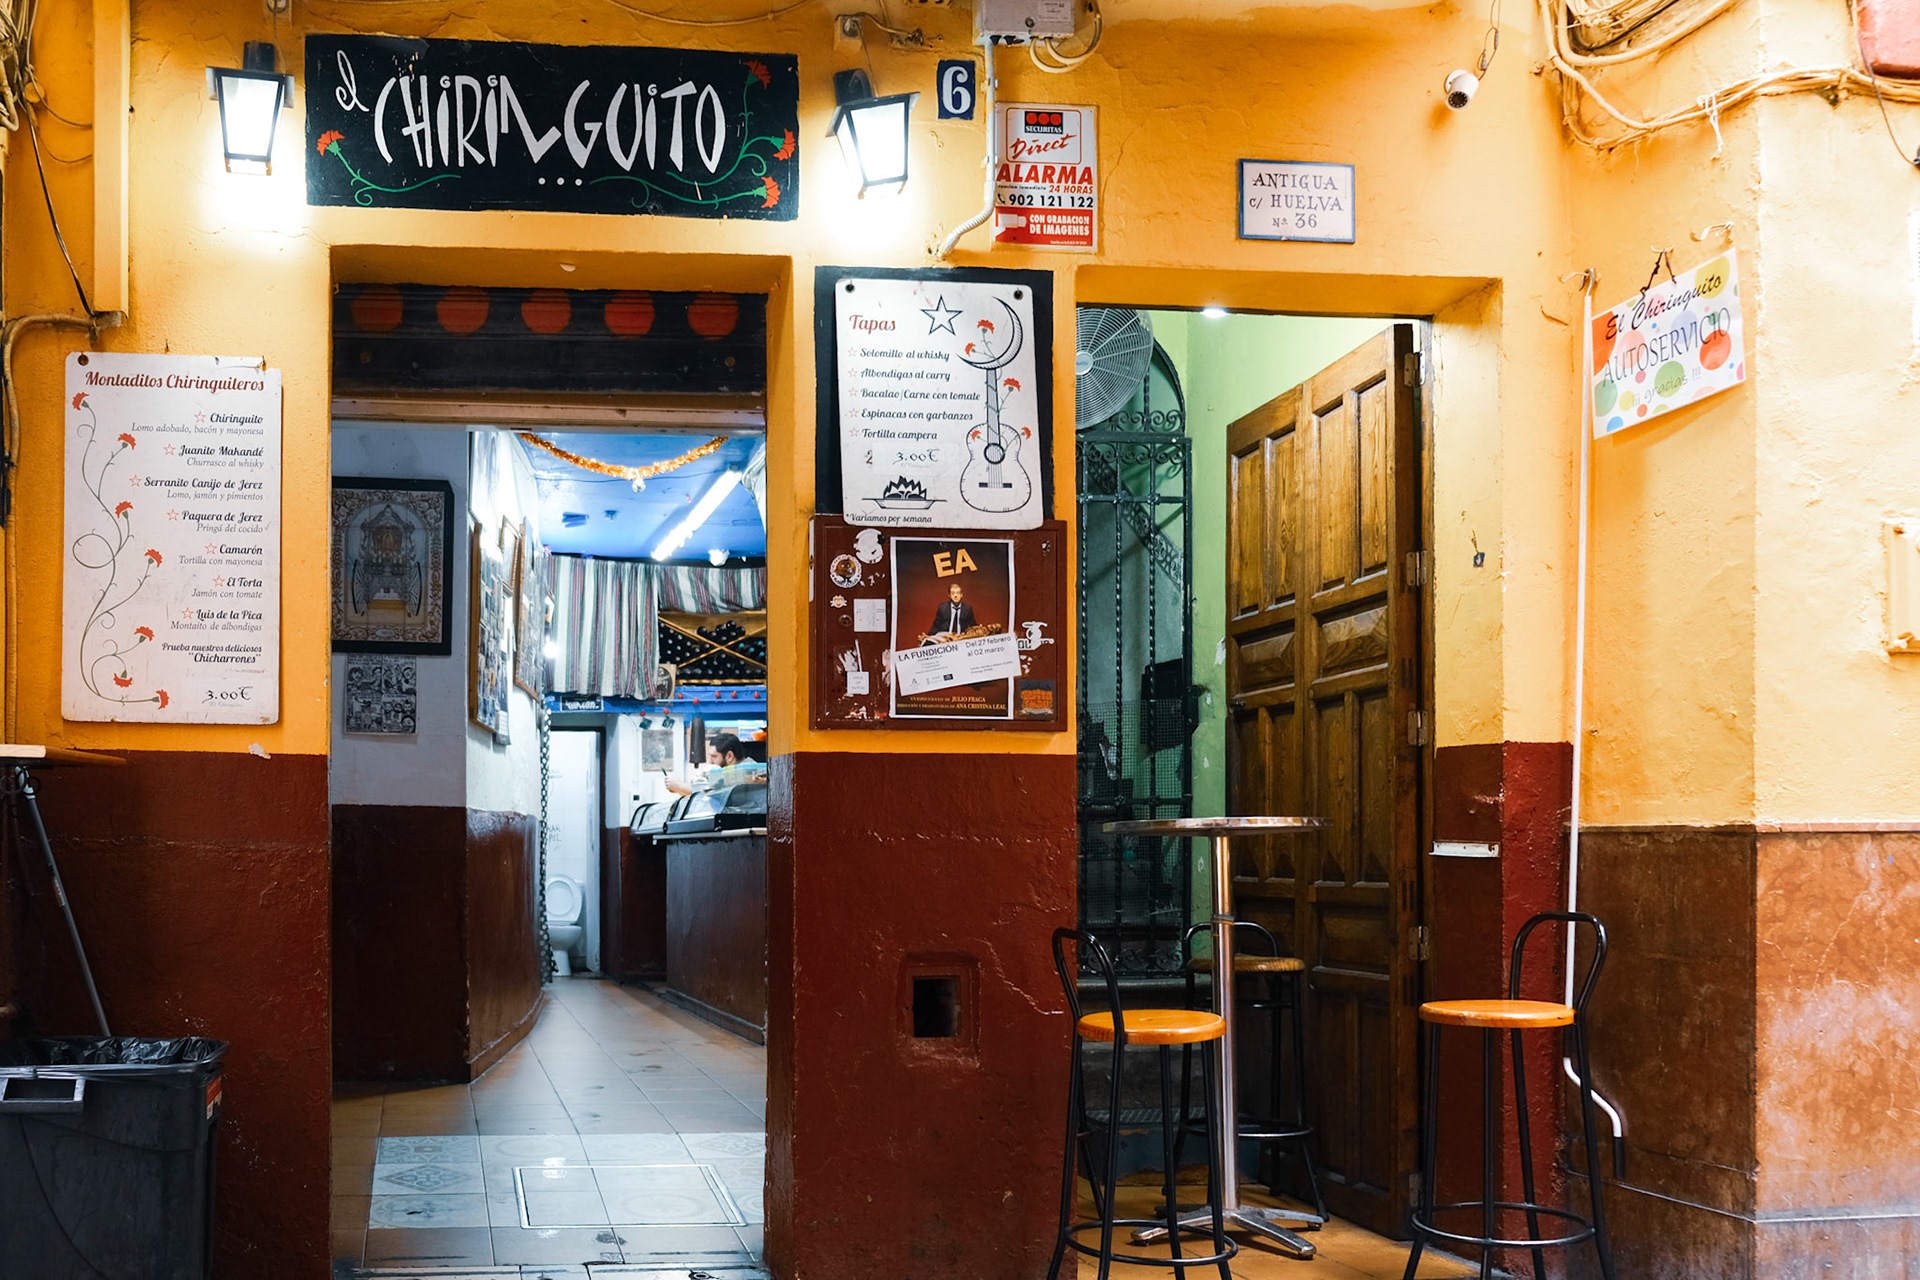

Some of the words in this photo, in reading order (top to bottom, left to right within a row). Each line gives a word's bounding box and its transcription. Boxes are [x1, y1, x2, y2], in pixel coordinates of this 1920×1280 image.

[941, 65, 971, 115] 6
[1009, 133, 1077, 160] Direct
[996, 164, 1093, 185] ALARMA
[1252, 172, 1339, 192] ANTIGUA
[1048, 185, 1061, 193] 24
[1063, 185, 1094, 195] HORAS
[1008, 194, 1034, 206] 902
[1040, 195, 1063, 207] 121
[1070, 196, 1094, 208] 122
[1270, 194, 1345, 212] HUELVA
[1029, 214, 1046, 224] CON
[1046, 215, 1090, 225] GRABACION
[1295, 212, 1318, 229] 36
[1029, 224, 1042, 235] DE
[1043, 225, 1090, 236] IMAGENES
[1605, 308, 1625, 340] El
[1631, 273, 1722, 331] Chiringuito
[848, 314, 897, 335] Tapas
[860, 347, 903, 358] Solomillo
[906, 349, 915, 359] al
[917, 350, 950, 362] whisky
[1602, 307, 1731, 388] AUTOSERVICIO
[860, 367, 913, 381] Albondigas
[915, 370, 924, 379] al
[925, 372, 951, 382] curry
[85, 371, 163, 388] Montaditos
[166, 373, 265, 395] Chiringuiteros
[1643, 374, 1689, 404] gracias
[949, 390, 981, 401] tomate
[209, 412, 263, 427] Chiringuito
[861, 408, 907, 421] Espinacas
[908, 411, 924, 420] con
[926, 411, 973, 422] garbanzos
[131, 422, 154, 432] Lomo
[156, 423, 192, 434] adobado,
[194, 424, 218, 434] bacón
[219, 427, 225, 436] y
[226, 427, 264, 437] mayonesa
[861, 428, 896, 439] Tortilla
[898, 431, 938, 441] campera
[178, 444, 216, 457] Juanito
[218, 445, 264, 457] Makandé
[186, 457, 227, 467] Churrasco
[228, 458, 236, 467] al
[238, 458, 264, 470] whisky
[144, 476, 189, 488] Serranito
[191, 477, 222, 492] Canijo
[224, 478, 236, 488] de
[237, 479, 263, 491] Jerez
[167, 489, 191, 501] Lomo,
[192, 490, 219, 502] jamón
[220, 494, 225, 503] y
[226, 491, 263, 503] pimientos
[182, 510, 223, 524] Paquera
[224, 511, 236, 522] de
[237, 512, 263, 524] Jerez
[226, 523, 236, 533] del
[238, 524, 263, 533] cocido
[219, 543, 263, 555] Camarón
[179, 555, 208, 565] Tortilla
[209, 558, 223, 566] con
[225, 558, 263, 567] mayonesa
[932, 547, 978, 579] EA
[226, 576, 236, 587] El
[237, 577, 263, 588] Torta
[191, 588, 218, 598] Jamón
[236, 590, 263, 599] tomate
[196, 609, 215, 621] Luis
[216, 610, 228, 619] de
[229, 610, 240, 619] la
[241, 610, 263, 620] Pica
[210, 621, 219, 630] de
[221, 622, 263, 632] albondigas
[161, 642, 190, 652] Prueba
[191, 644, 224, 652] nuestros
[224, 644, 262, 653] deliciosos
[965, 640, 977, 648] Del
[978, 639, 986, 647] 27
[987, 636, 1012, 646] febrero
[898, 653, 910, 662] LA
[910, 644, 959, 660] FUNDICIÓN
[974, 648, 984, 656] 02
[984, 646, 1005, 654] marzo
